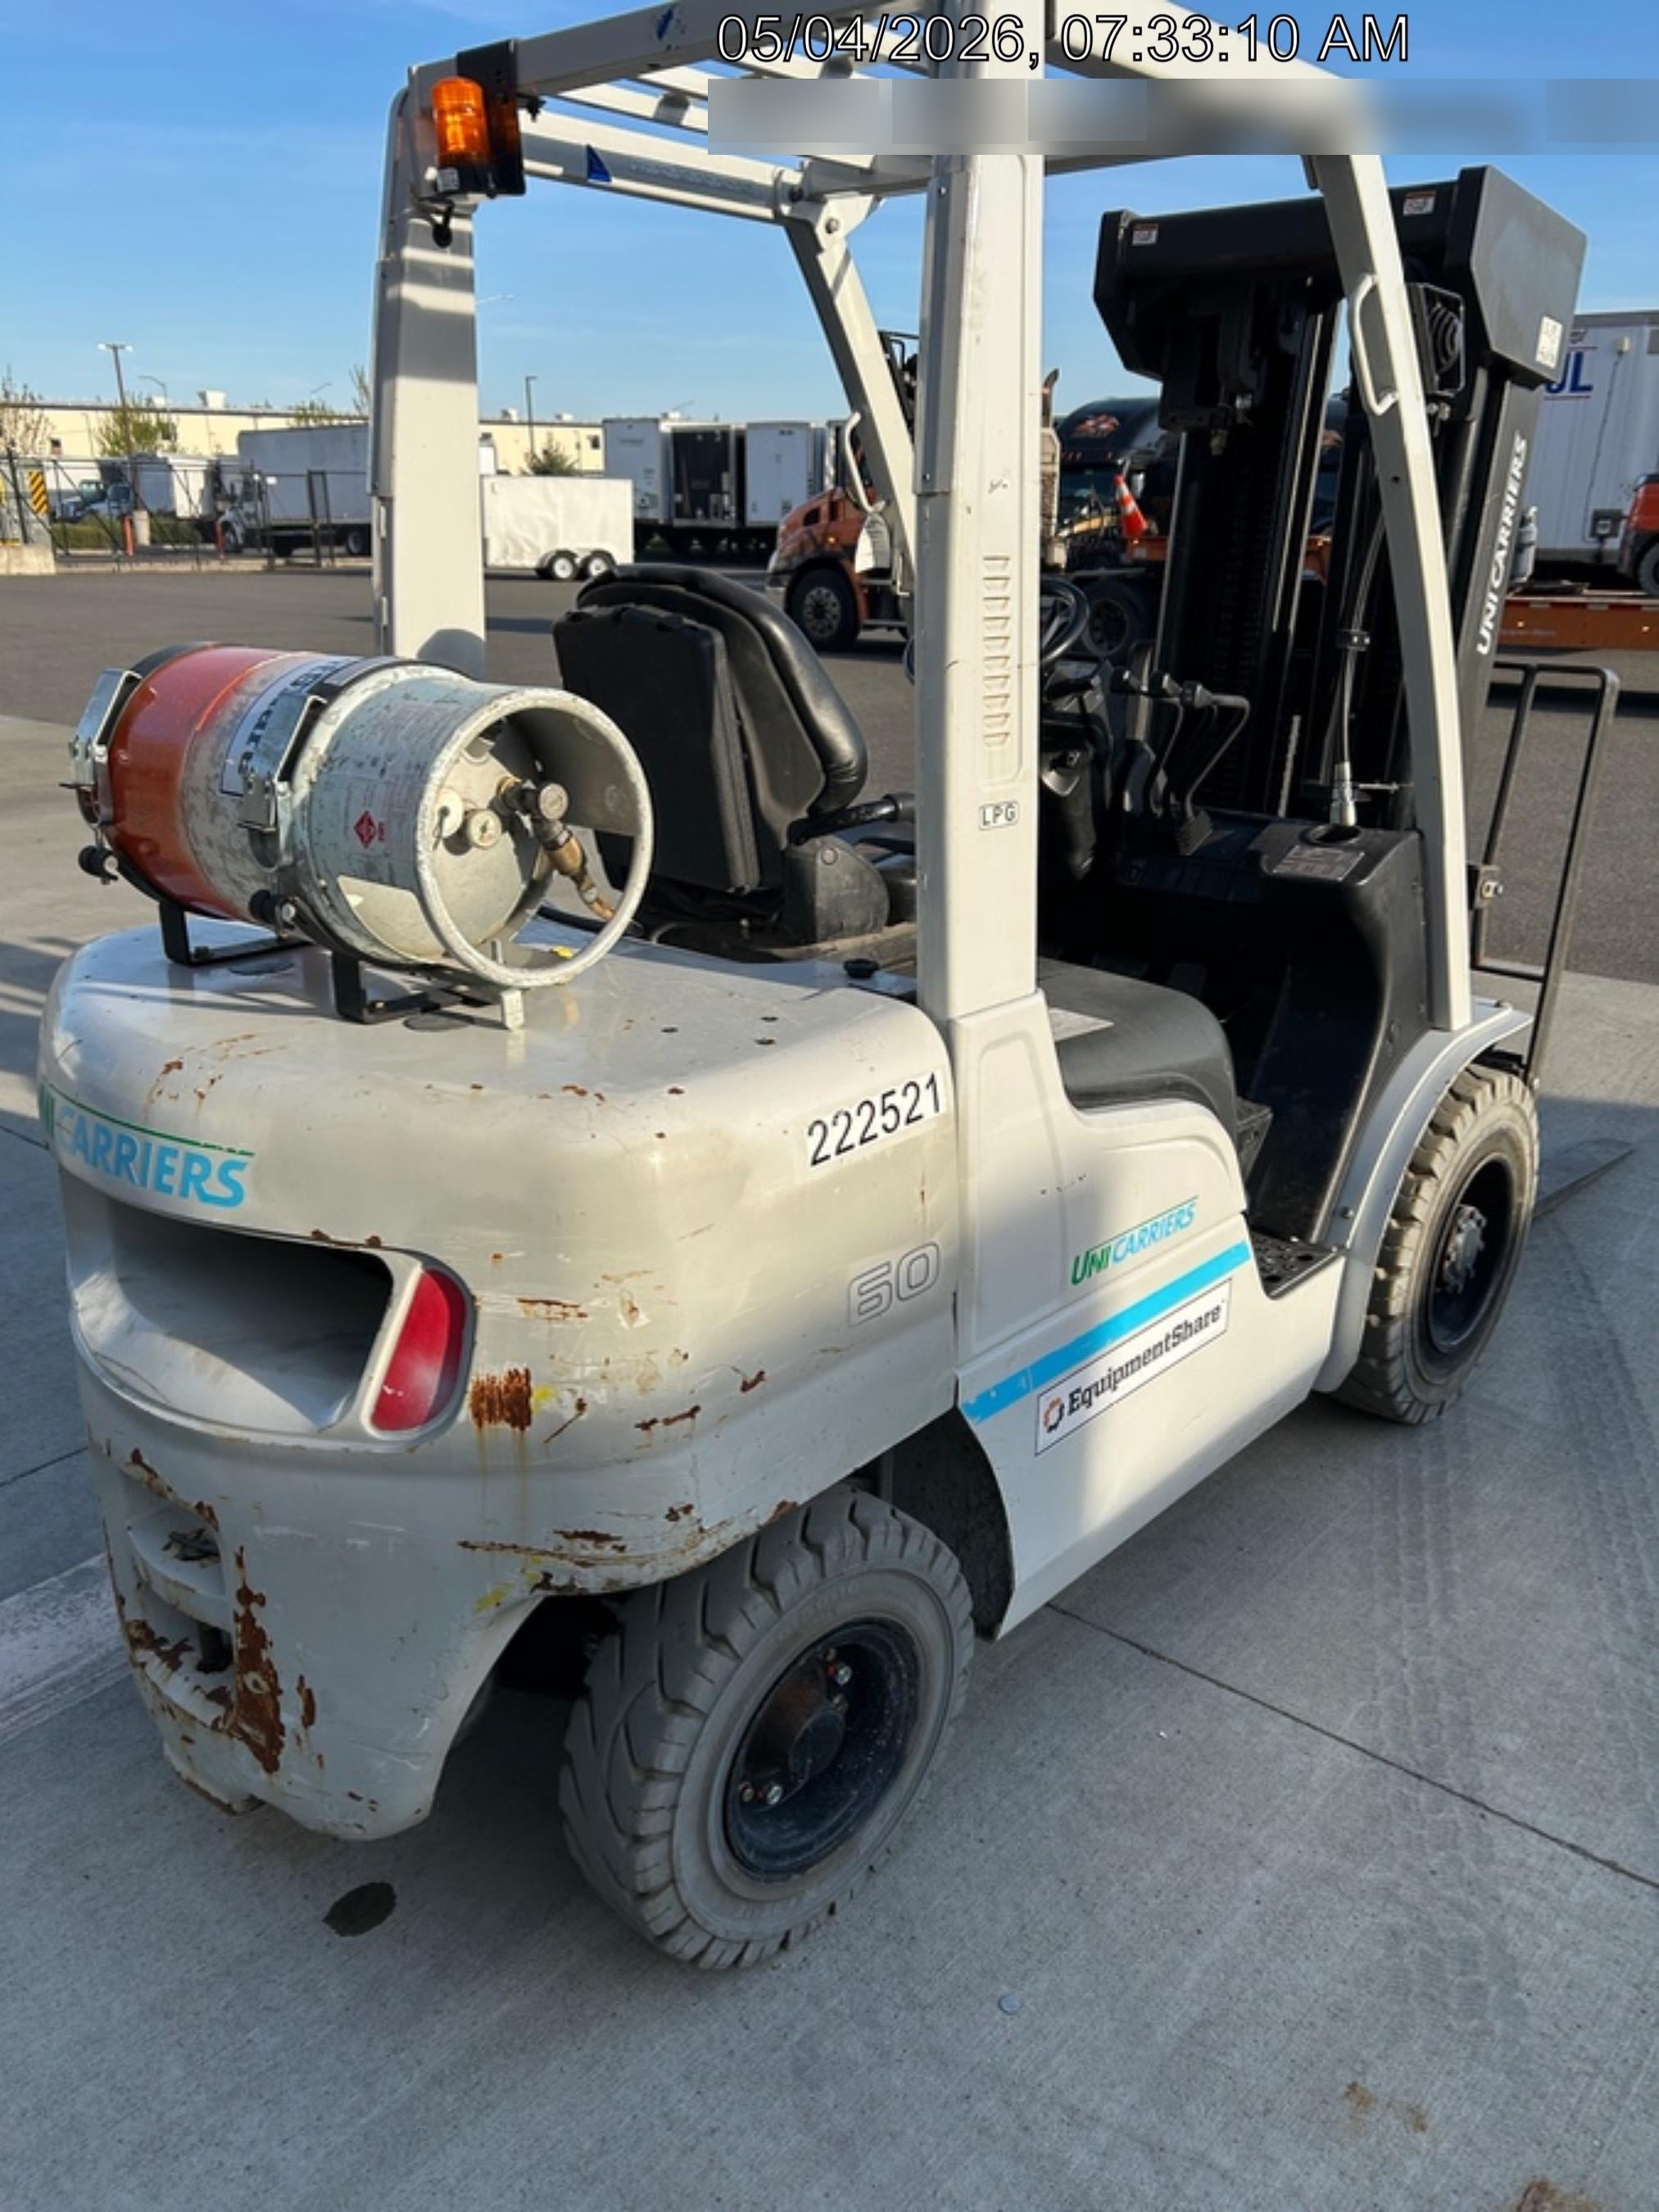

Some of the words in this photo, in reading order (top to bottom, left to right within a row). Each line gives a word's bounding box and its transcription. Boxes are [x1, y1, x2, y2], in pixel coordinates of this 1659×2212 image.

[1477, 430, 1527, 655] UNICARRIERS
[982, 803, 1016, 826] LPG
[39, 1083, 248, 1208] CARRIERS
[808, 1072, 941, 1167] 222521
[848, 1240, 940, 1327] 60
[1067, 1304, 1222, 1416] EquipmentShare
